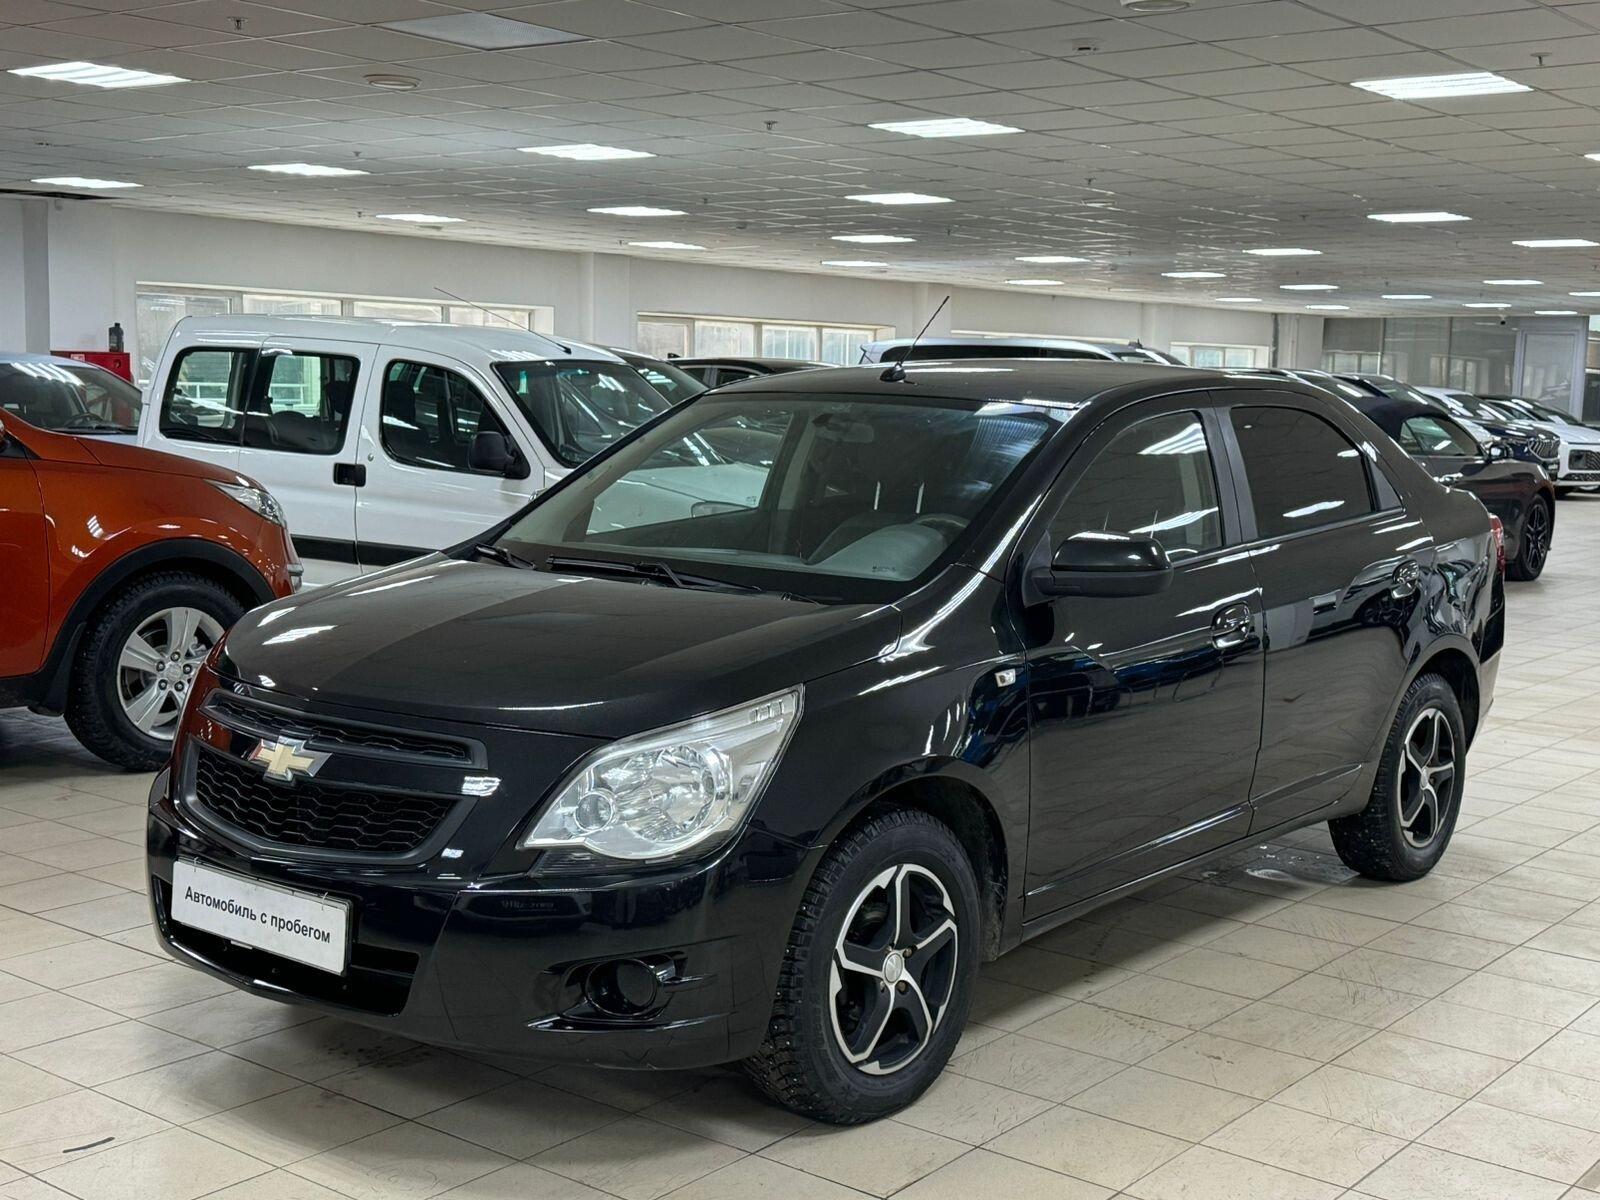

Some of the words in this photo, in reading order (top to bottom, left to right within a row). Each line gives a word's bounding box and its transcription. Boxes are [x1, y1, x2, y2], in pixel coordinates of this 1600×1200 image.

[185, 886, 257, 921] Автомобиль
[260, 912, 267, 924] с
[271, 915, 331, 943] пробегом
